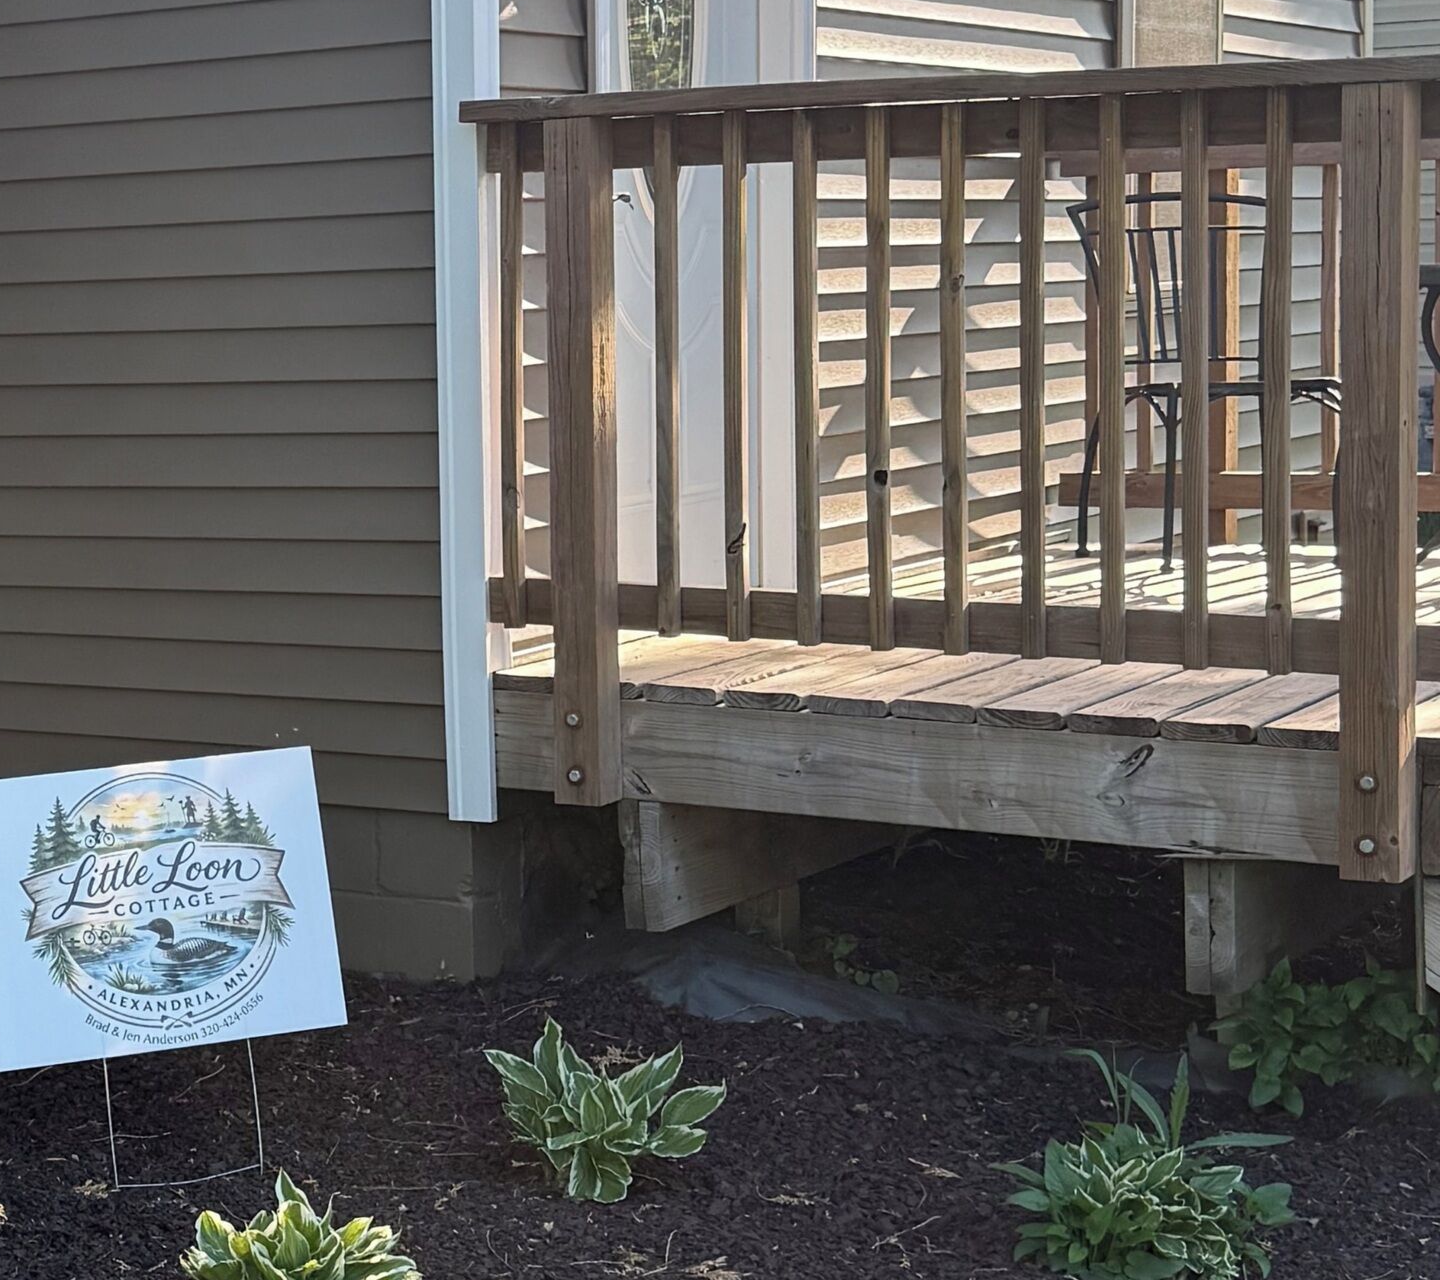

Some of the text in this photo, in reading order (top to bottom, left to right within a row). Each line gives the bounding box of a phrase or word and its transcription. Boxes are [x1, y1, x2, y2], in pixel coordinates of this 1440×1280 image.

[51, 840, 261, 920] Little Loon
[114, 891, 215, 917] COTTAGE
[97, 968, 249, 1012] ALEXANDRIA, MN
[85, 1013, 110, 1034] Brad
[111, 1026, 120, 1037] &
[122, 1028, 141, 1043] Jen
[142, 1031, 199, 1046] Anderson
